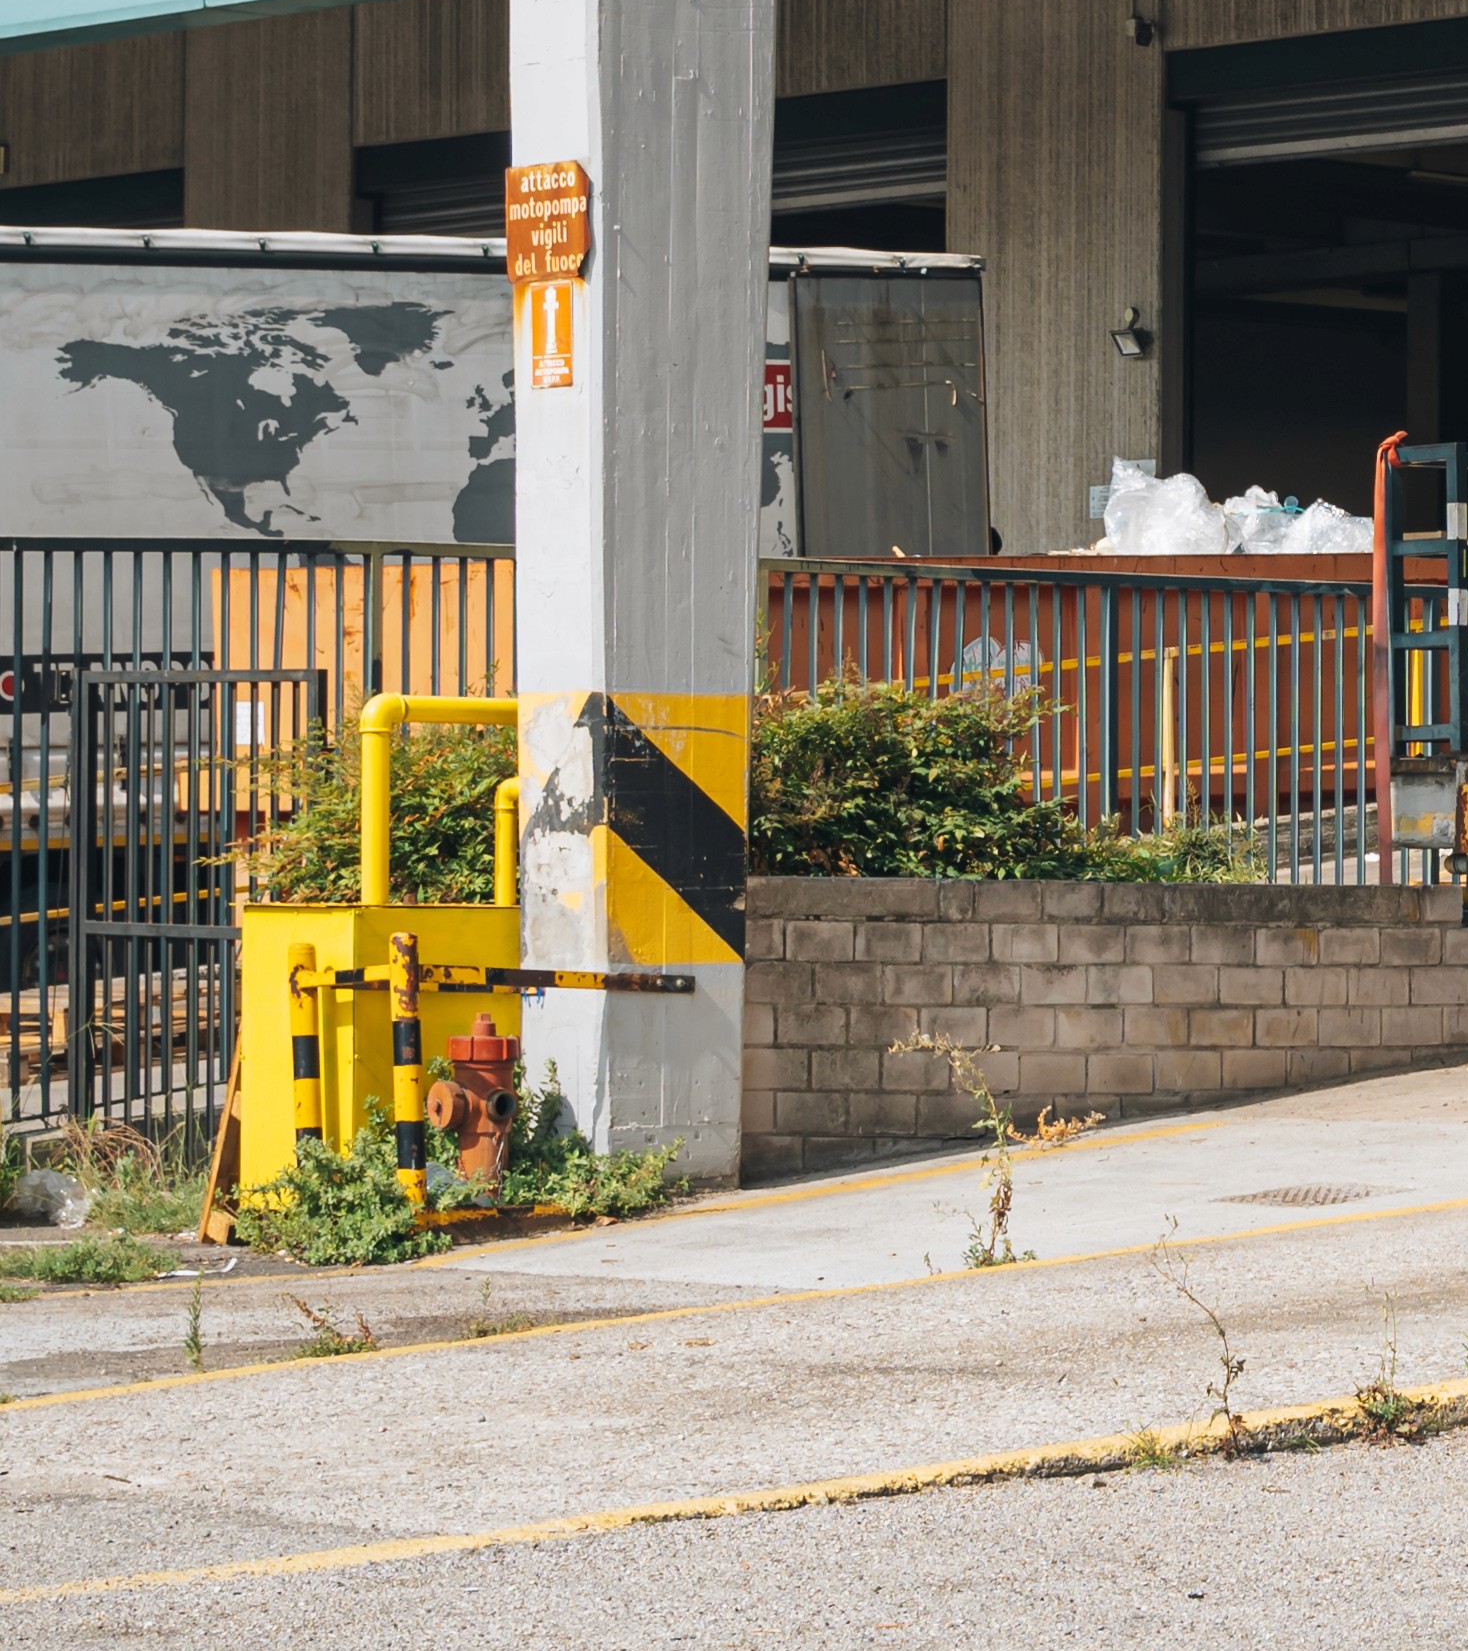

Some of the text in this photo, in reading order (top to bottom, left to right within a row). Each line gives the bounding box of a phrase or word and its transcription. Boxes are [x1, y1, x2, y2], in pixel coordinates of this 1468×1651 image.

[521, 170, 576, 193] attacco
[509, 195, 587, 222] motopompa
[531, 220, 567, 249] vigili
[515, 252, 537, 276] del
